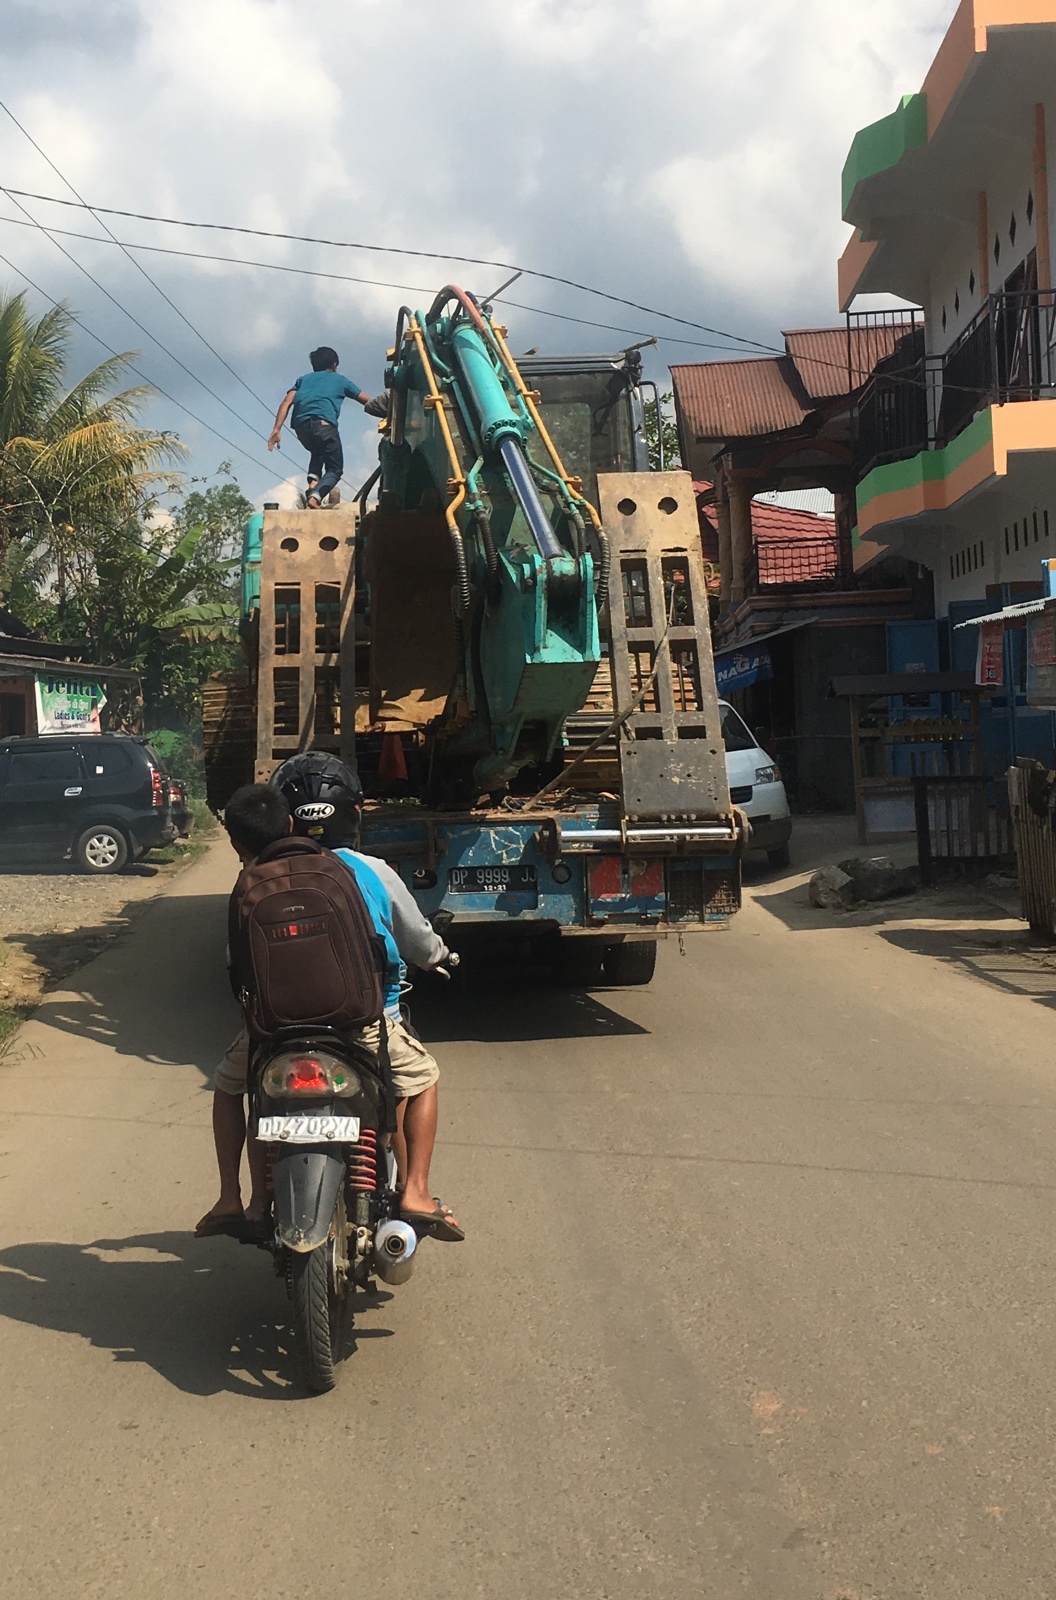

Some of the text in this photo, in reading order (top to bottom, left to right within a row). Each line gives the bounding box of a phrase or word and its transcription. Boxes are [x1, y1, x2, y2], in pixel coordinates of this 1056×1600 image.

[43, 676, 97, 697] Jelita
[54, 710, 70, 721] Ladies
[300, 805, 329, 817] NHK
[452, 869, 468, 885] DP
[476, 868, 510, 884] 9999
